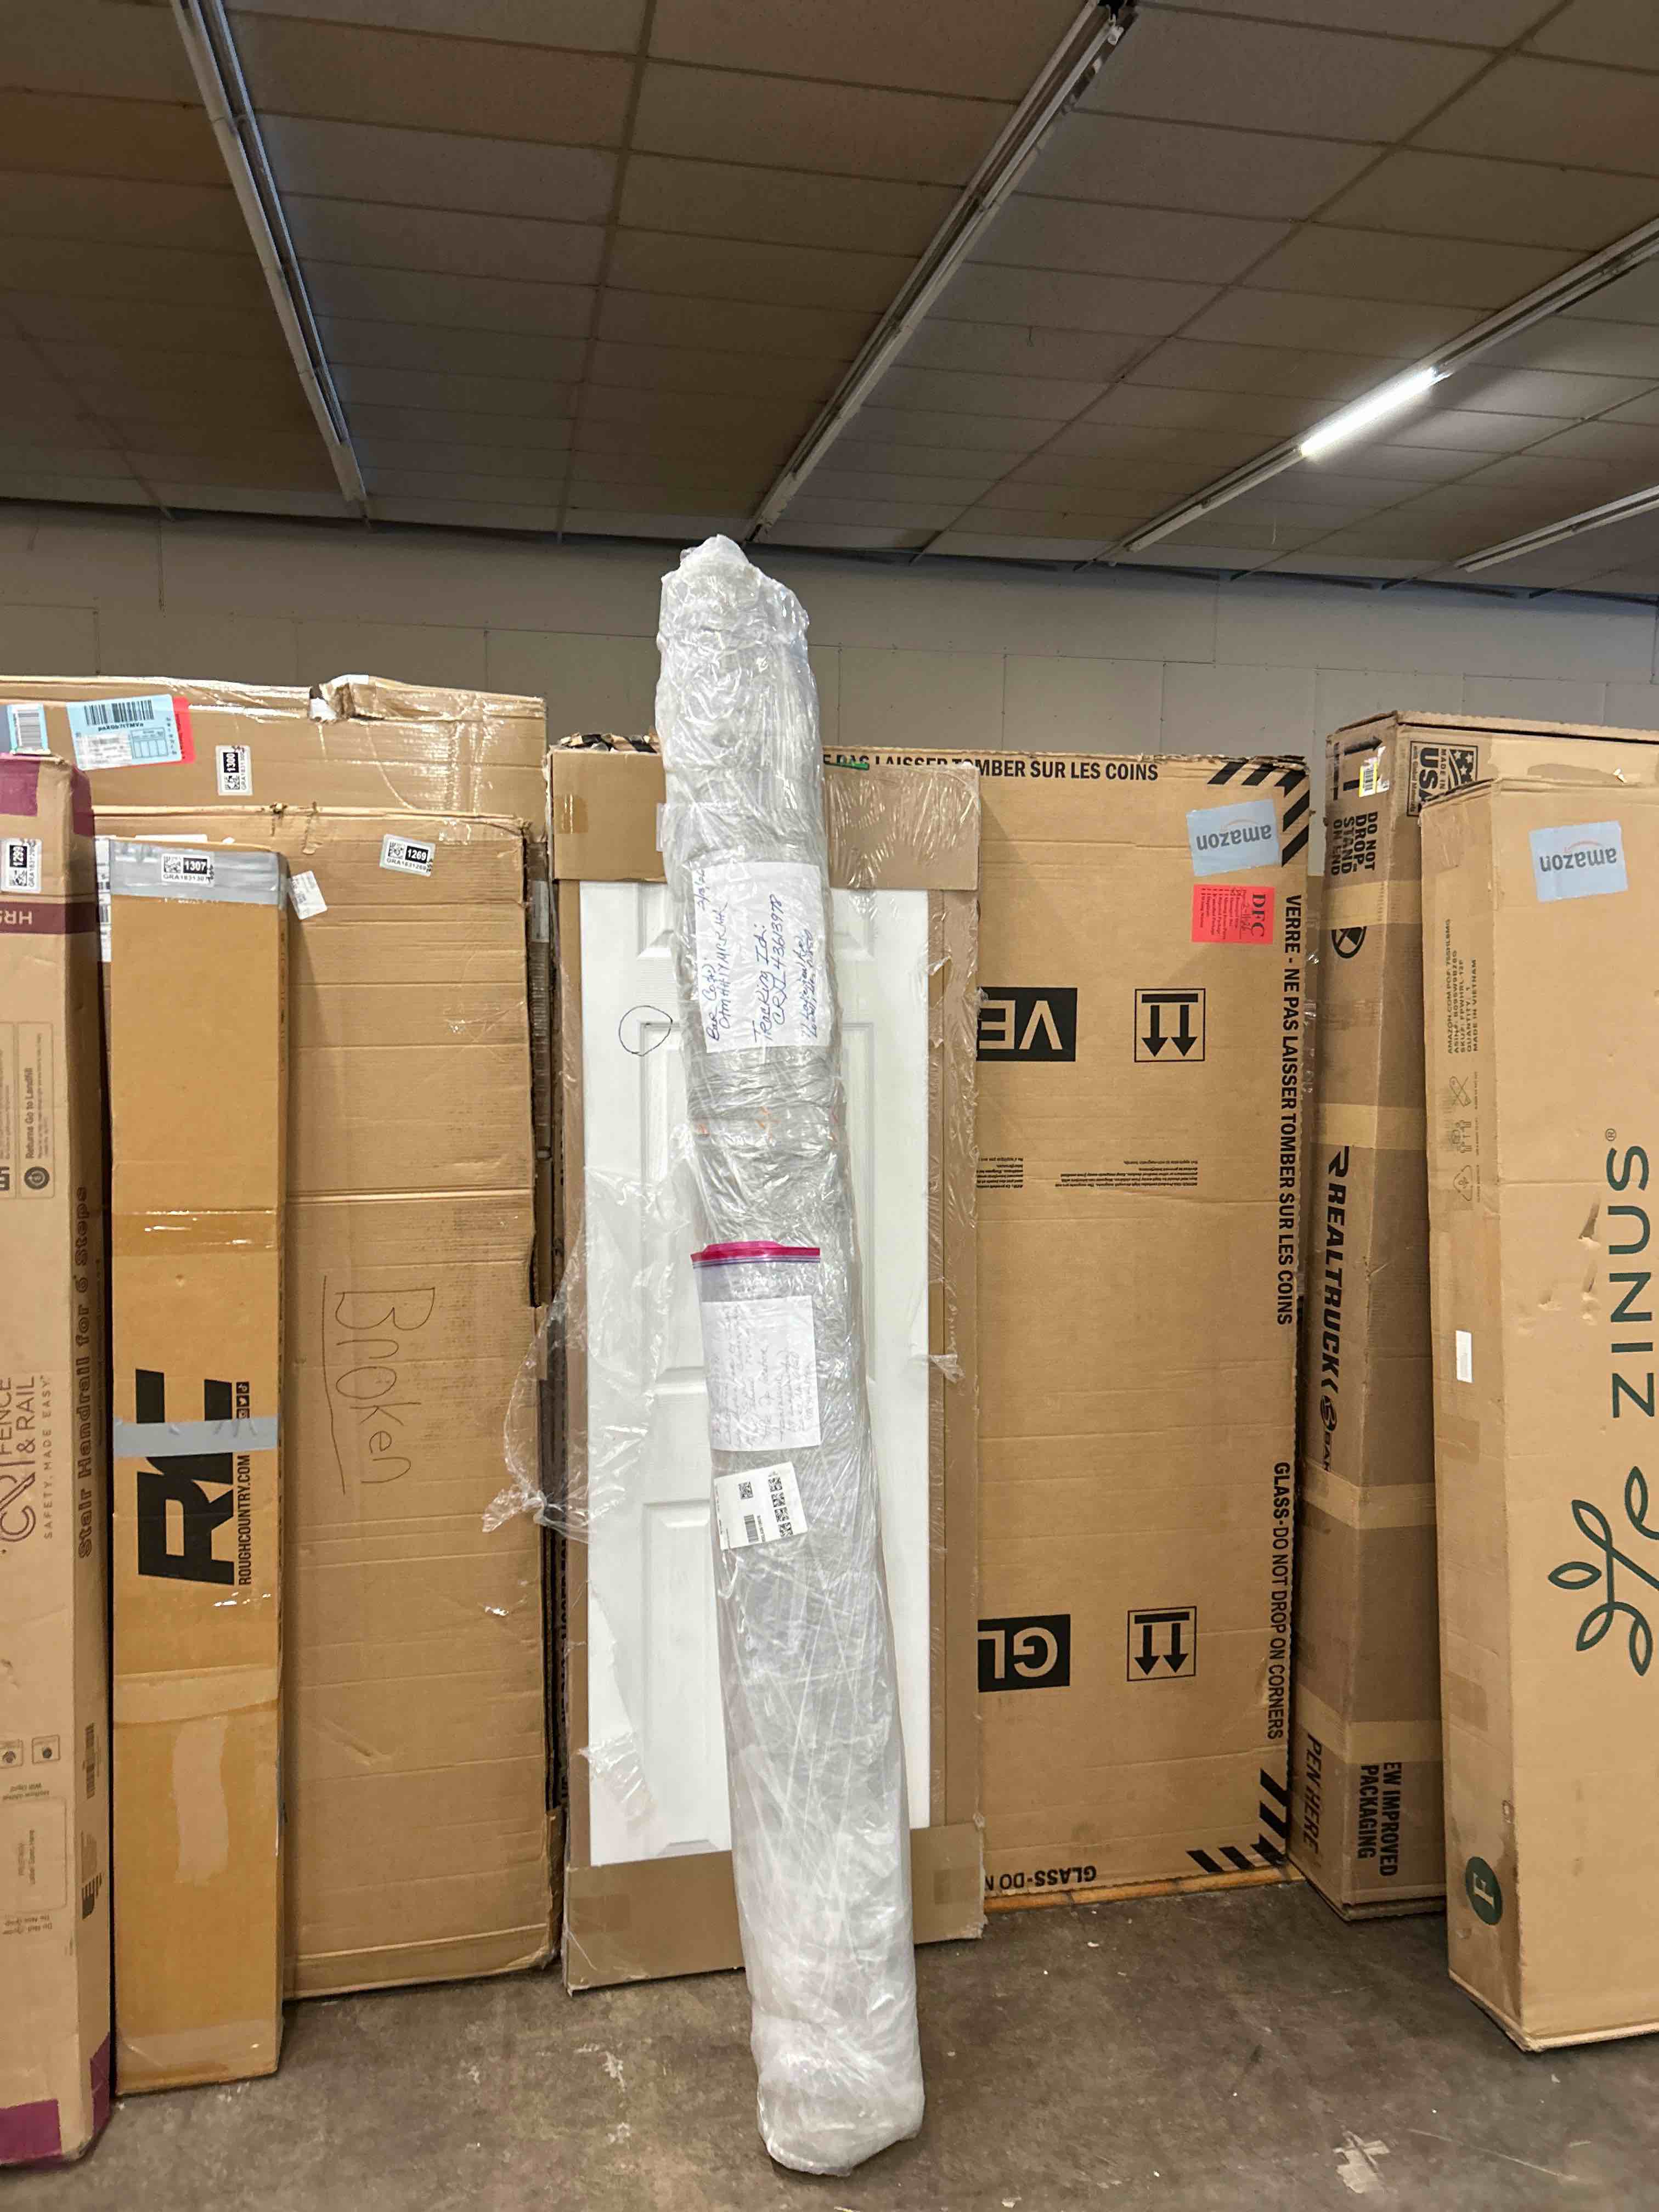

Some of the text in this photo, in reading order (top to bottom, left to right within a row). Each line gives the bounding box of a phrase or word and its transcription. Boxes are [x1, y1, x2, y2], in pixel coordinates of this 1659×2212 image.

[225, 753, 236, 772] 1300
[1030, 760, 1065, 778] SUR
[1071, 762, 1100, 779] LES
[1105, 763, 1158, 780] COINS
[1440, 780, 1446, 789] IN
[407, 848, 427, 862] 1269
[1196, 825, 1272, 852] amazon
[1331, 819, 1343, 876] ON END
[1341, 816, 1355, 874] STAND
[1354, 814, 1367, 865] DROP
[1365, 811, 1378, 871] DO NOT
[1539, 848, 1617, 873] amazon
[184, 859, 206, 872] 1307
[0, 910, 33, 926] HR
[1250, 894, 1266, 936] DFC
[1284, 895, 1302, 953] VERRE
[1284, 968, 1300, 992] NE
[1283, 997, 1300, 1031] PAS
[1471, 1009, 1477, 1019] IN
[1282, 1036, 1299, 1109] LAISSER
[24, 1067, 35, 1159] Returns Go to Landfill
[1280, 1113, 1296, 1188] TOMBER
[74, 1186, 91, 1267] Steps
[1279, 1193, 1295, 1229] SUR
[1278, 1234, 1294, 1265] LES
[1277, 1270, 1293, 1325] COINS
[1322, 1182, 1347, 1378] REALTRUCK
[1606, 1146, 1656, 1419] ZINUS
[75, 1304, 89, 1347] for
[15, 1376, 35, 1453] & RAIL
[75, 1356, 93, 1479] Handrail
[42, 1429, 52, 1470] MADE
[77, 1488, 93, 1559] Stair
[236, 1455, 252, 1585] ROUGHCOUNTRY.COM
[1272, 1554, 1288, 1585] NOT
[1271, 1590, 1288, 1633] DROP
[1269, 1637, 1286, 1659] ON
[1267, 1664, 1285, 1739] CORNERS
[1303, 1733, 1322, 1854] PEN HERE
[1357, 1764, 1380, 1860] PACKAGING
[1380, 1762, 1402, 1877] EW IMPROVED
